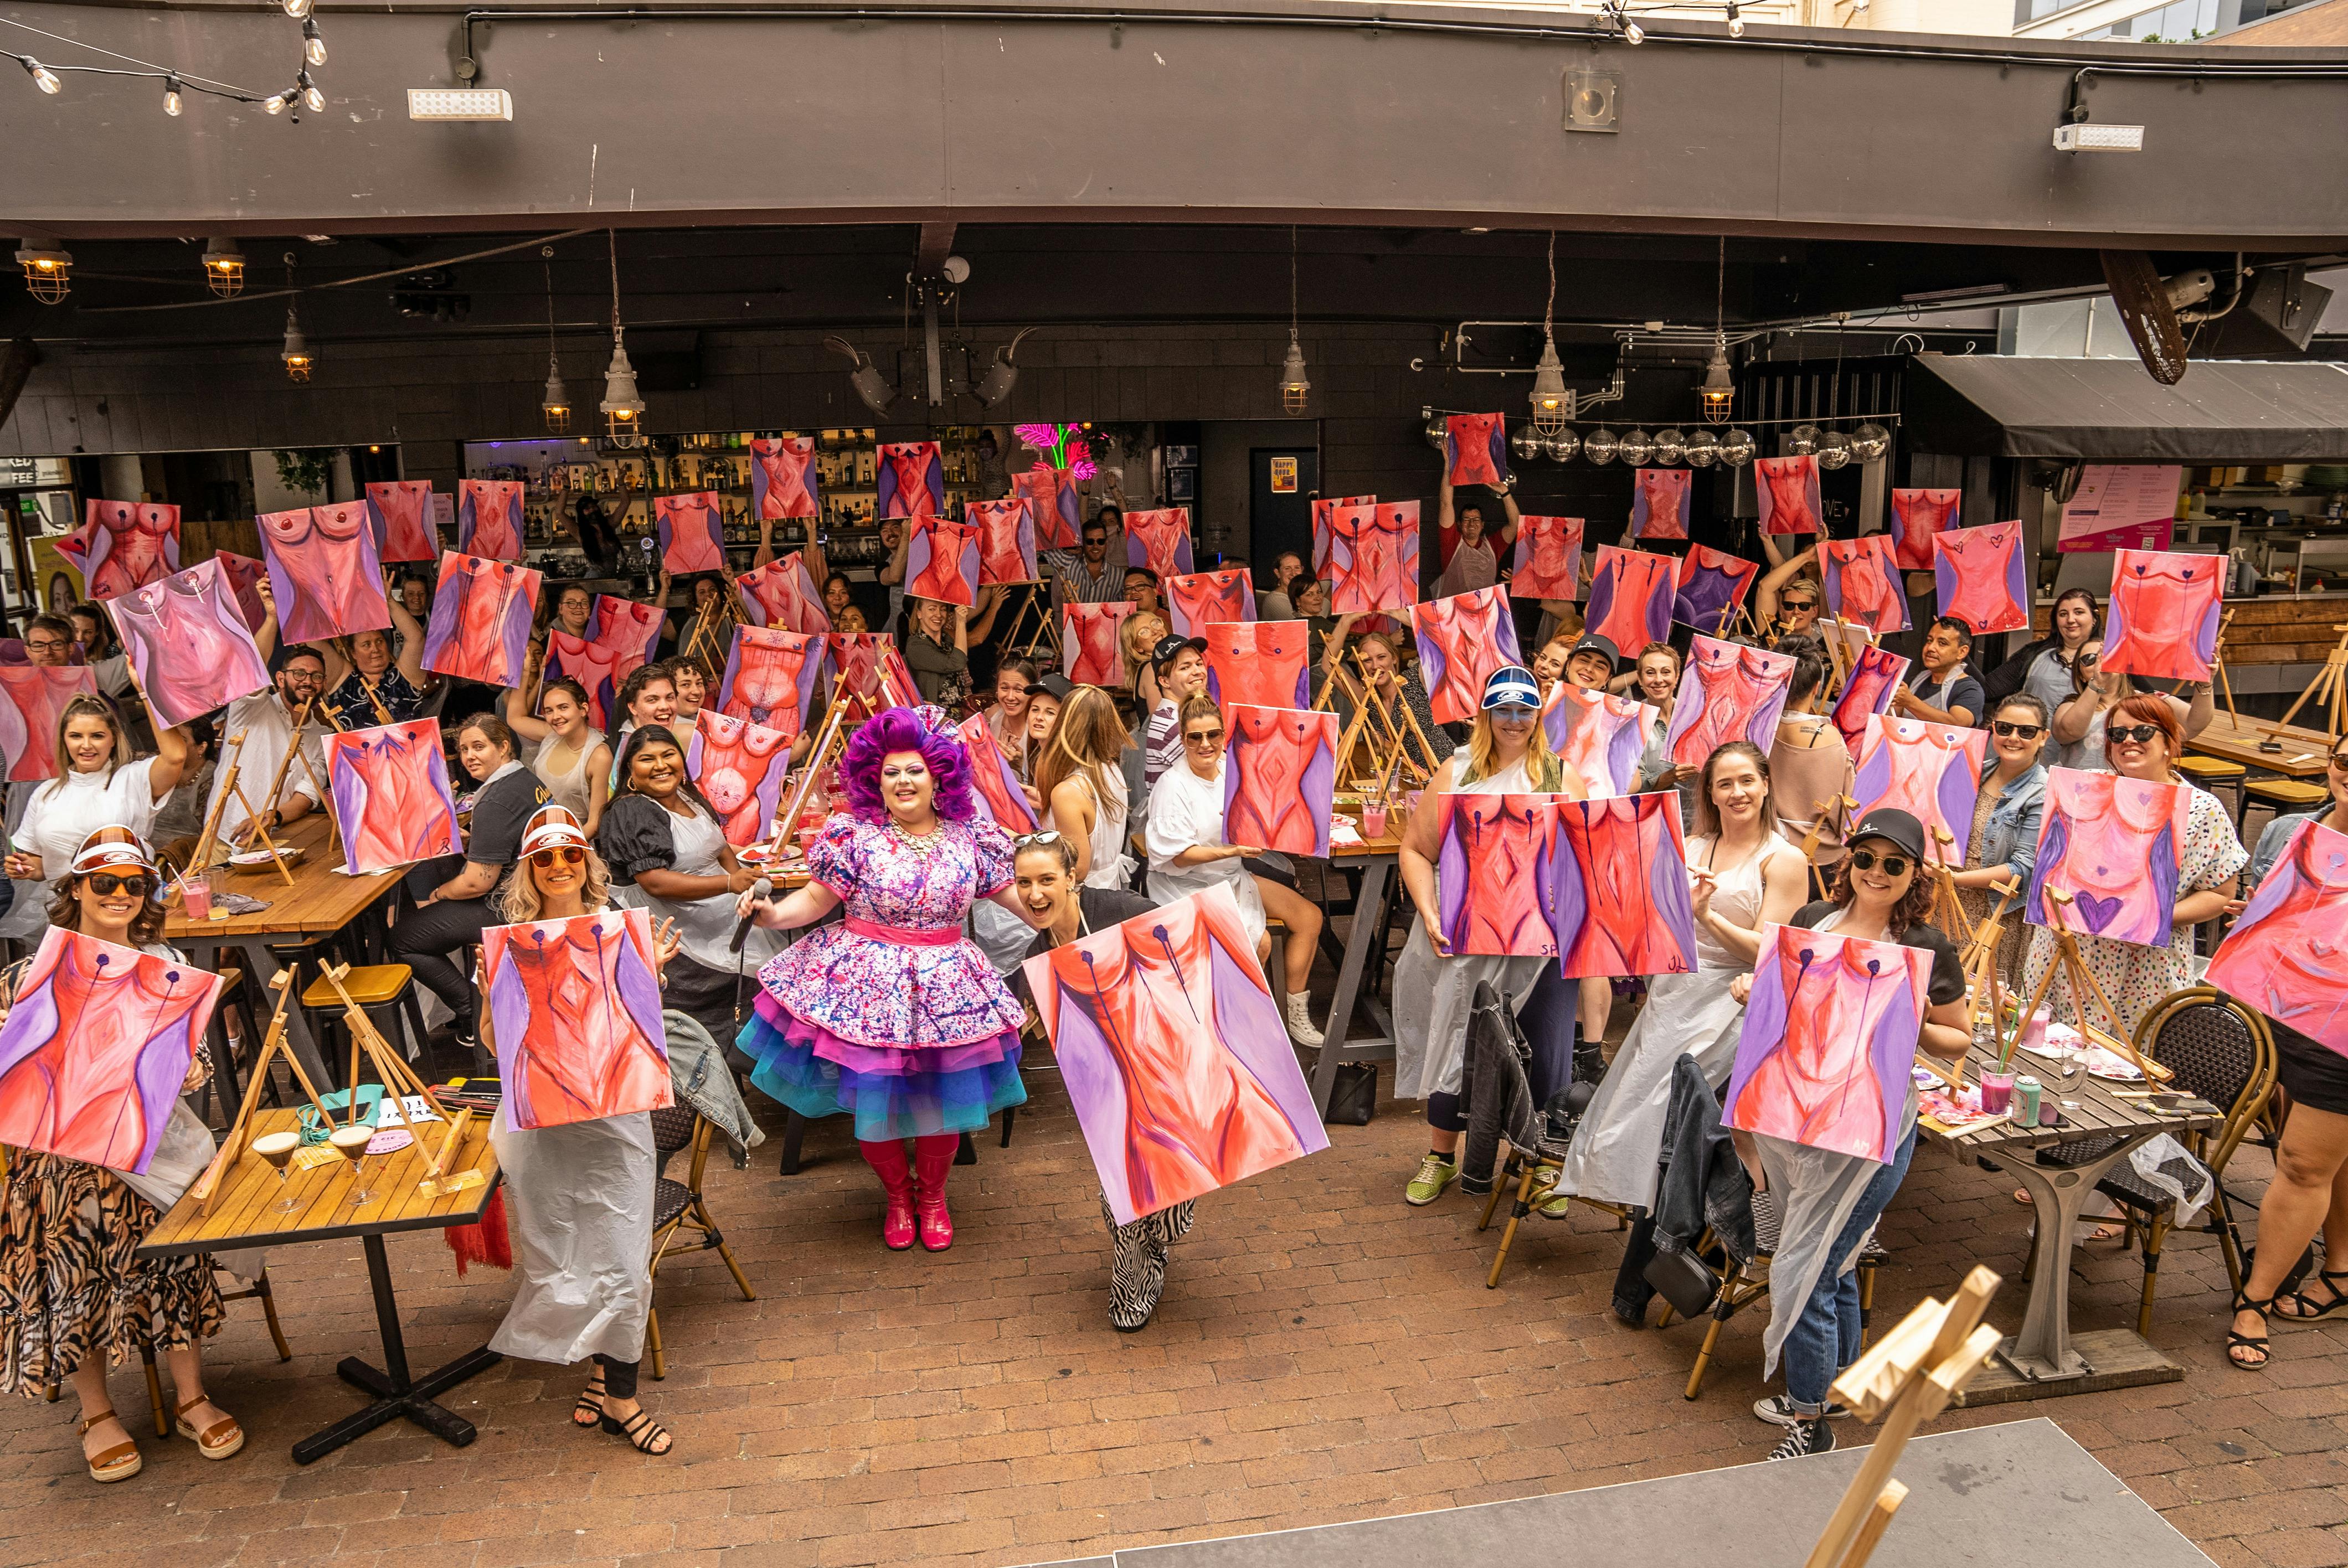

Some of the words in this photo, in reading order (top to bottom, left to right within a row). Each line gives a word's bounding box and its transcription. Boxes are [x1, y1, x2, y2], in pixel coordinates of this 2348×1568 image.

[395, 633, 404, 643] 69
[1541, 944, 1557, 956] SP
[1852, 1138, 1870, 1152] AM
